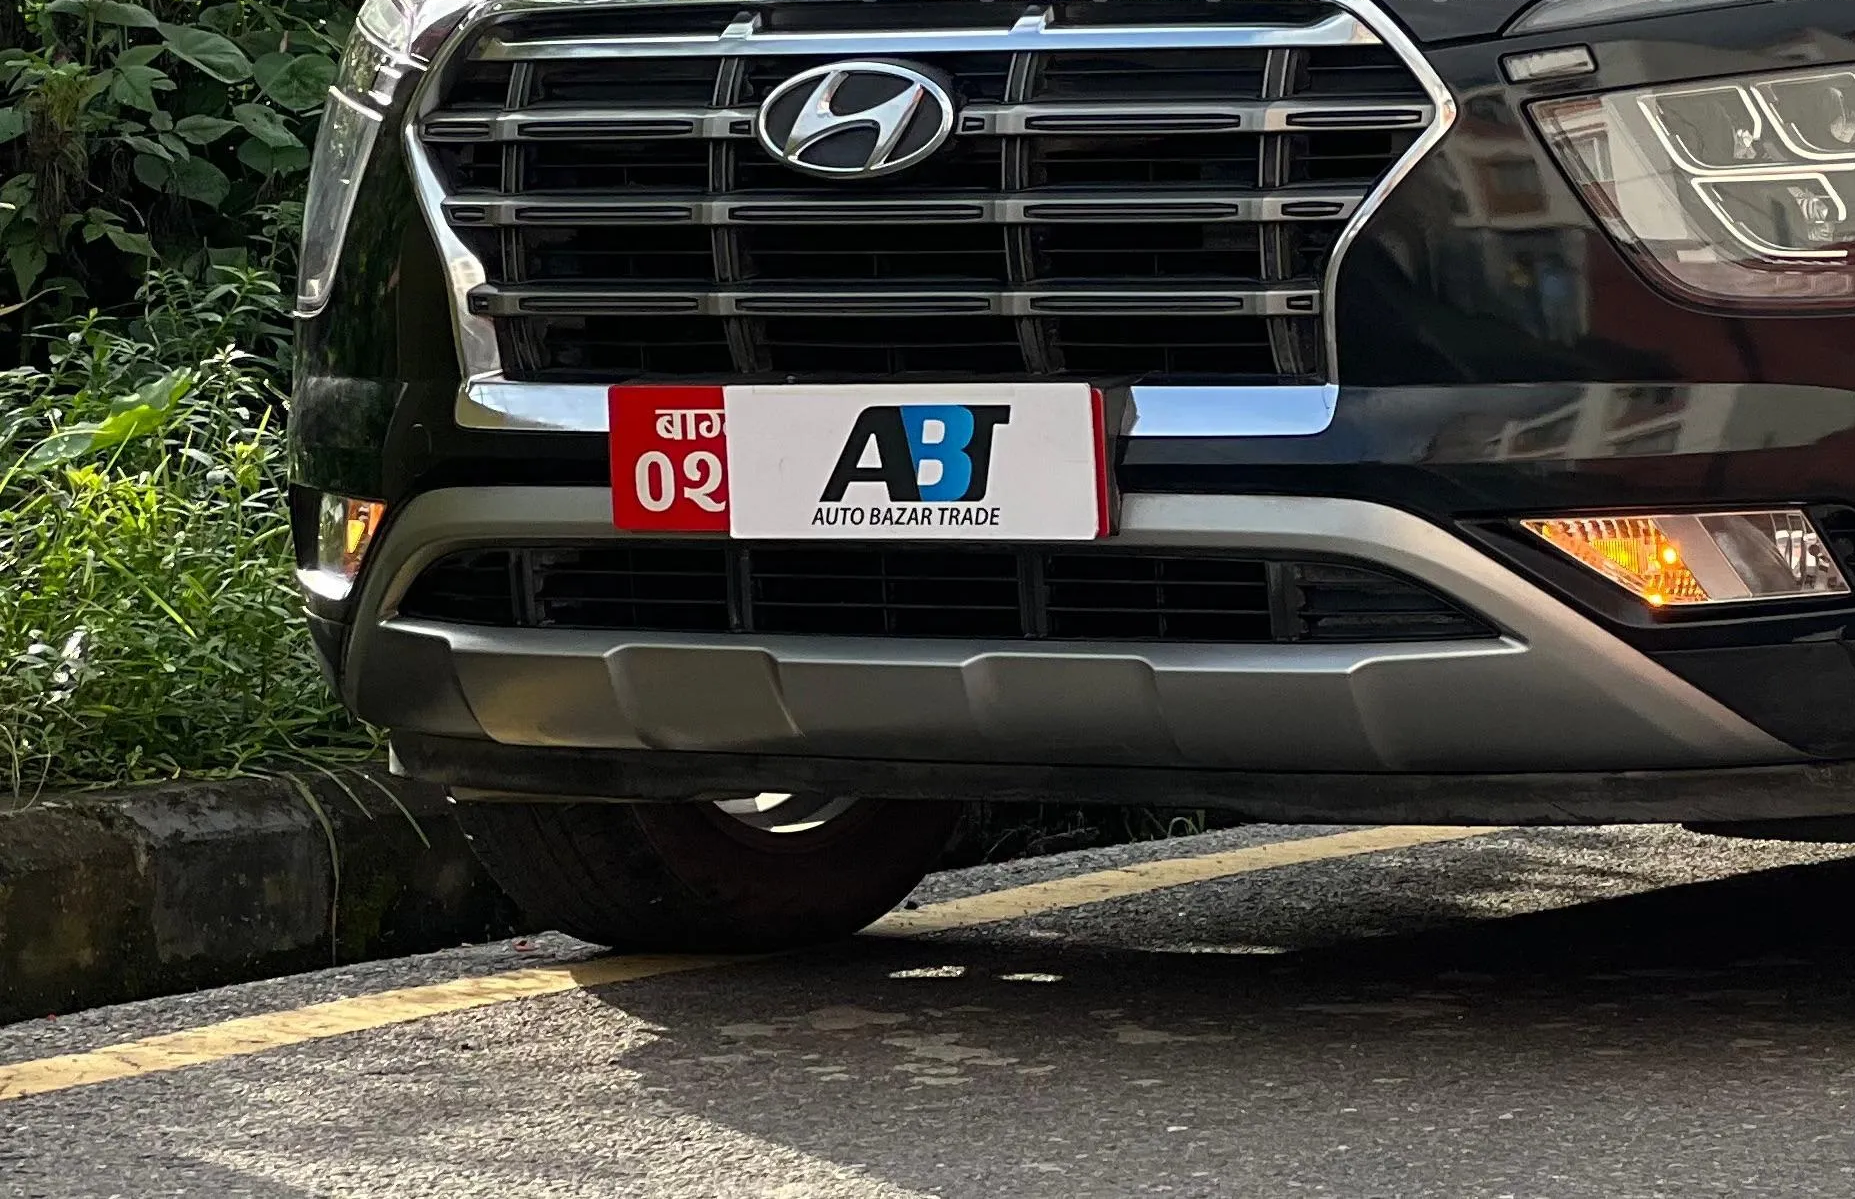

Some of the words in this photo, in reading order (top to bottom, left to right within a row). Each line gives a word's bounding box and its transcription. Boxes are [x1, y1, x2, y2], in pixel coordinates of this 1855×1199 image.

[819, 404, 1011, 502] ABT
[812, 507, 865, 526] AUTO
[869, 507, 933, 526] BAZAR
[938, 507, 1001, 526] TRADE
